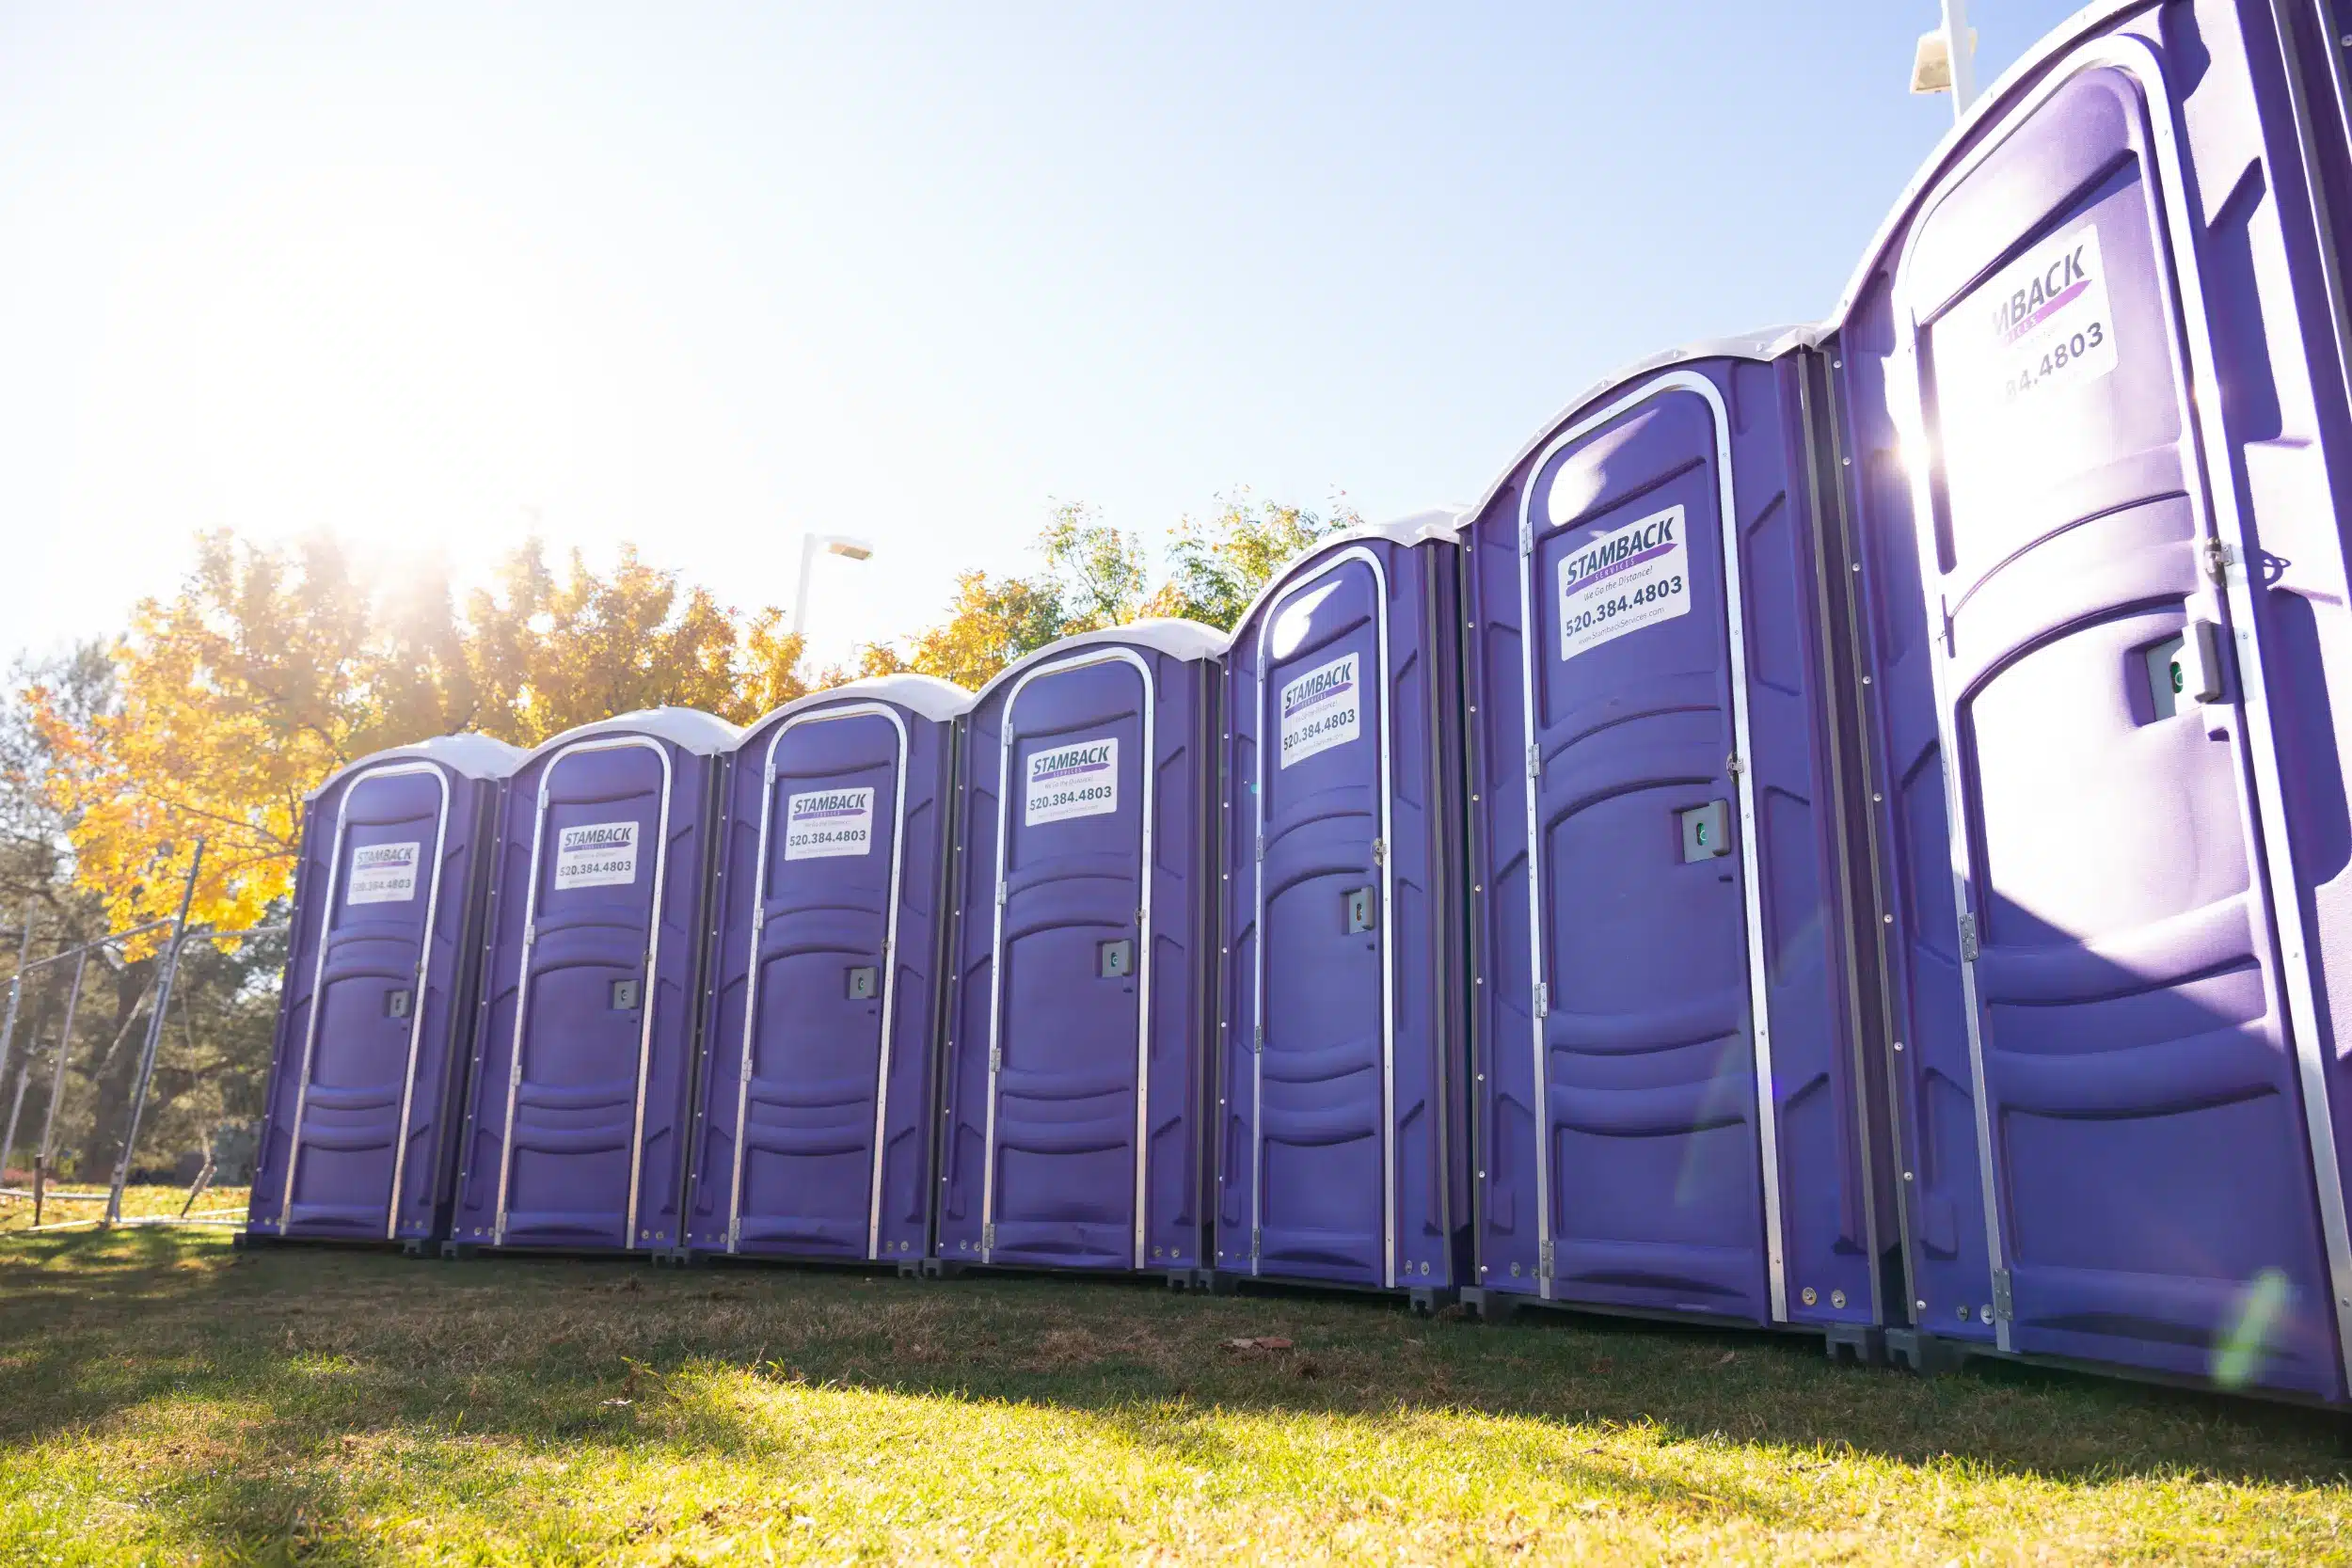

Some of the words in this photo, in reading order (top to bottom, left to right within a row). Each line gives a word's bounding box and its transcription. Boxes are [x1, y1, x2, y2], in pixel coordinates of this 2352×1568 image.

[1992, 245, 2086, 337] MBACK
[2005, 322, 2104, 404] 84.4803
[1566, 516, 1675, 586] STAMBACK
[1583, 591, 1595, 602] We
[1595, 586, 1605, 596] Go
[1605, 580, 1617, 593] the
[1618, 564, 1653, 587] Distance!
[1595, 558, 1636, 581] SERVICES
[1565, 575, 1682, 638] 520.384.4803
[1285, 661, 1353, 710] STAMBACK
[1283, 707, 1356, 752] 520.384.4803
[1033, 745, 1110, 776] STAMBACK
[794, 793, 867, 815] STAMBACK
[1029, 785, 1112, 811] 520.384.4803
[564, 827, 632, 847] STAMBACK
[789, 830, 866, 847] 520.384.4803
[358, 847, 414, 863] STAMBACK
[560, 861, 631, 877] 520.384.4803
[353, 878, 411, 893] 0.384.4803
